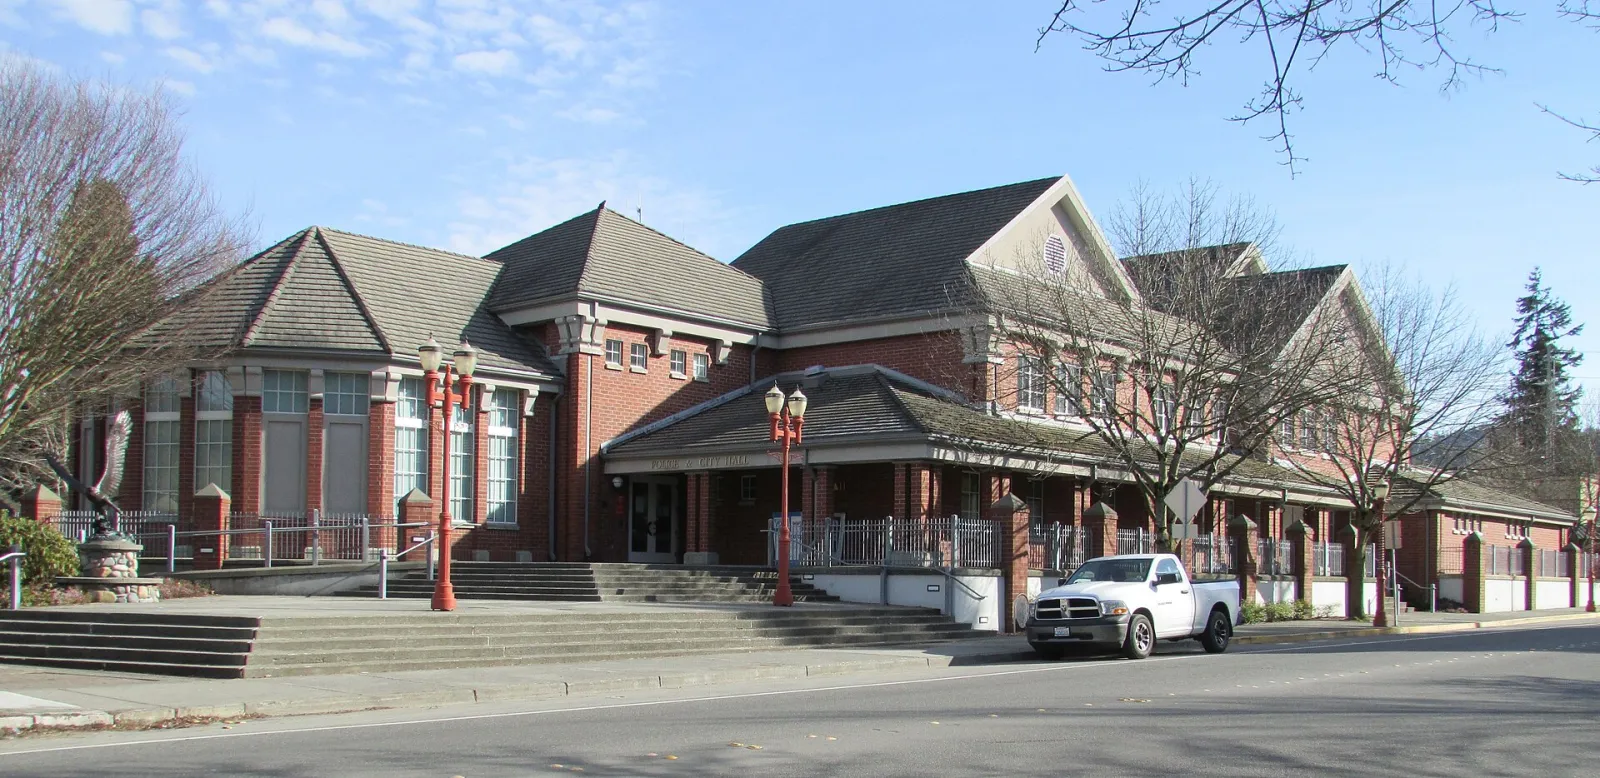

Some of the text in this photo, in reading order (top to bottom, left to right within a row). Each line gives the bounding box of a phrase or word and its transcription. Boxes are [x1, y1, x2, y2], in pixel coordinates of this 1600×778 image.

[686, 460, 693, 468] &
[698, 456, 721, 467] CITY
[724, 455, 749, 466] HALL
